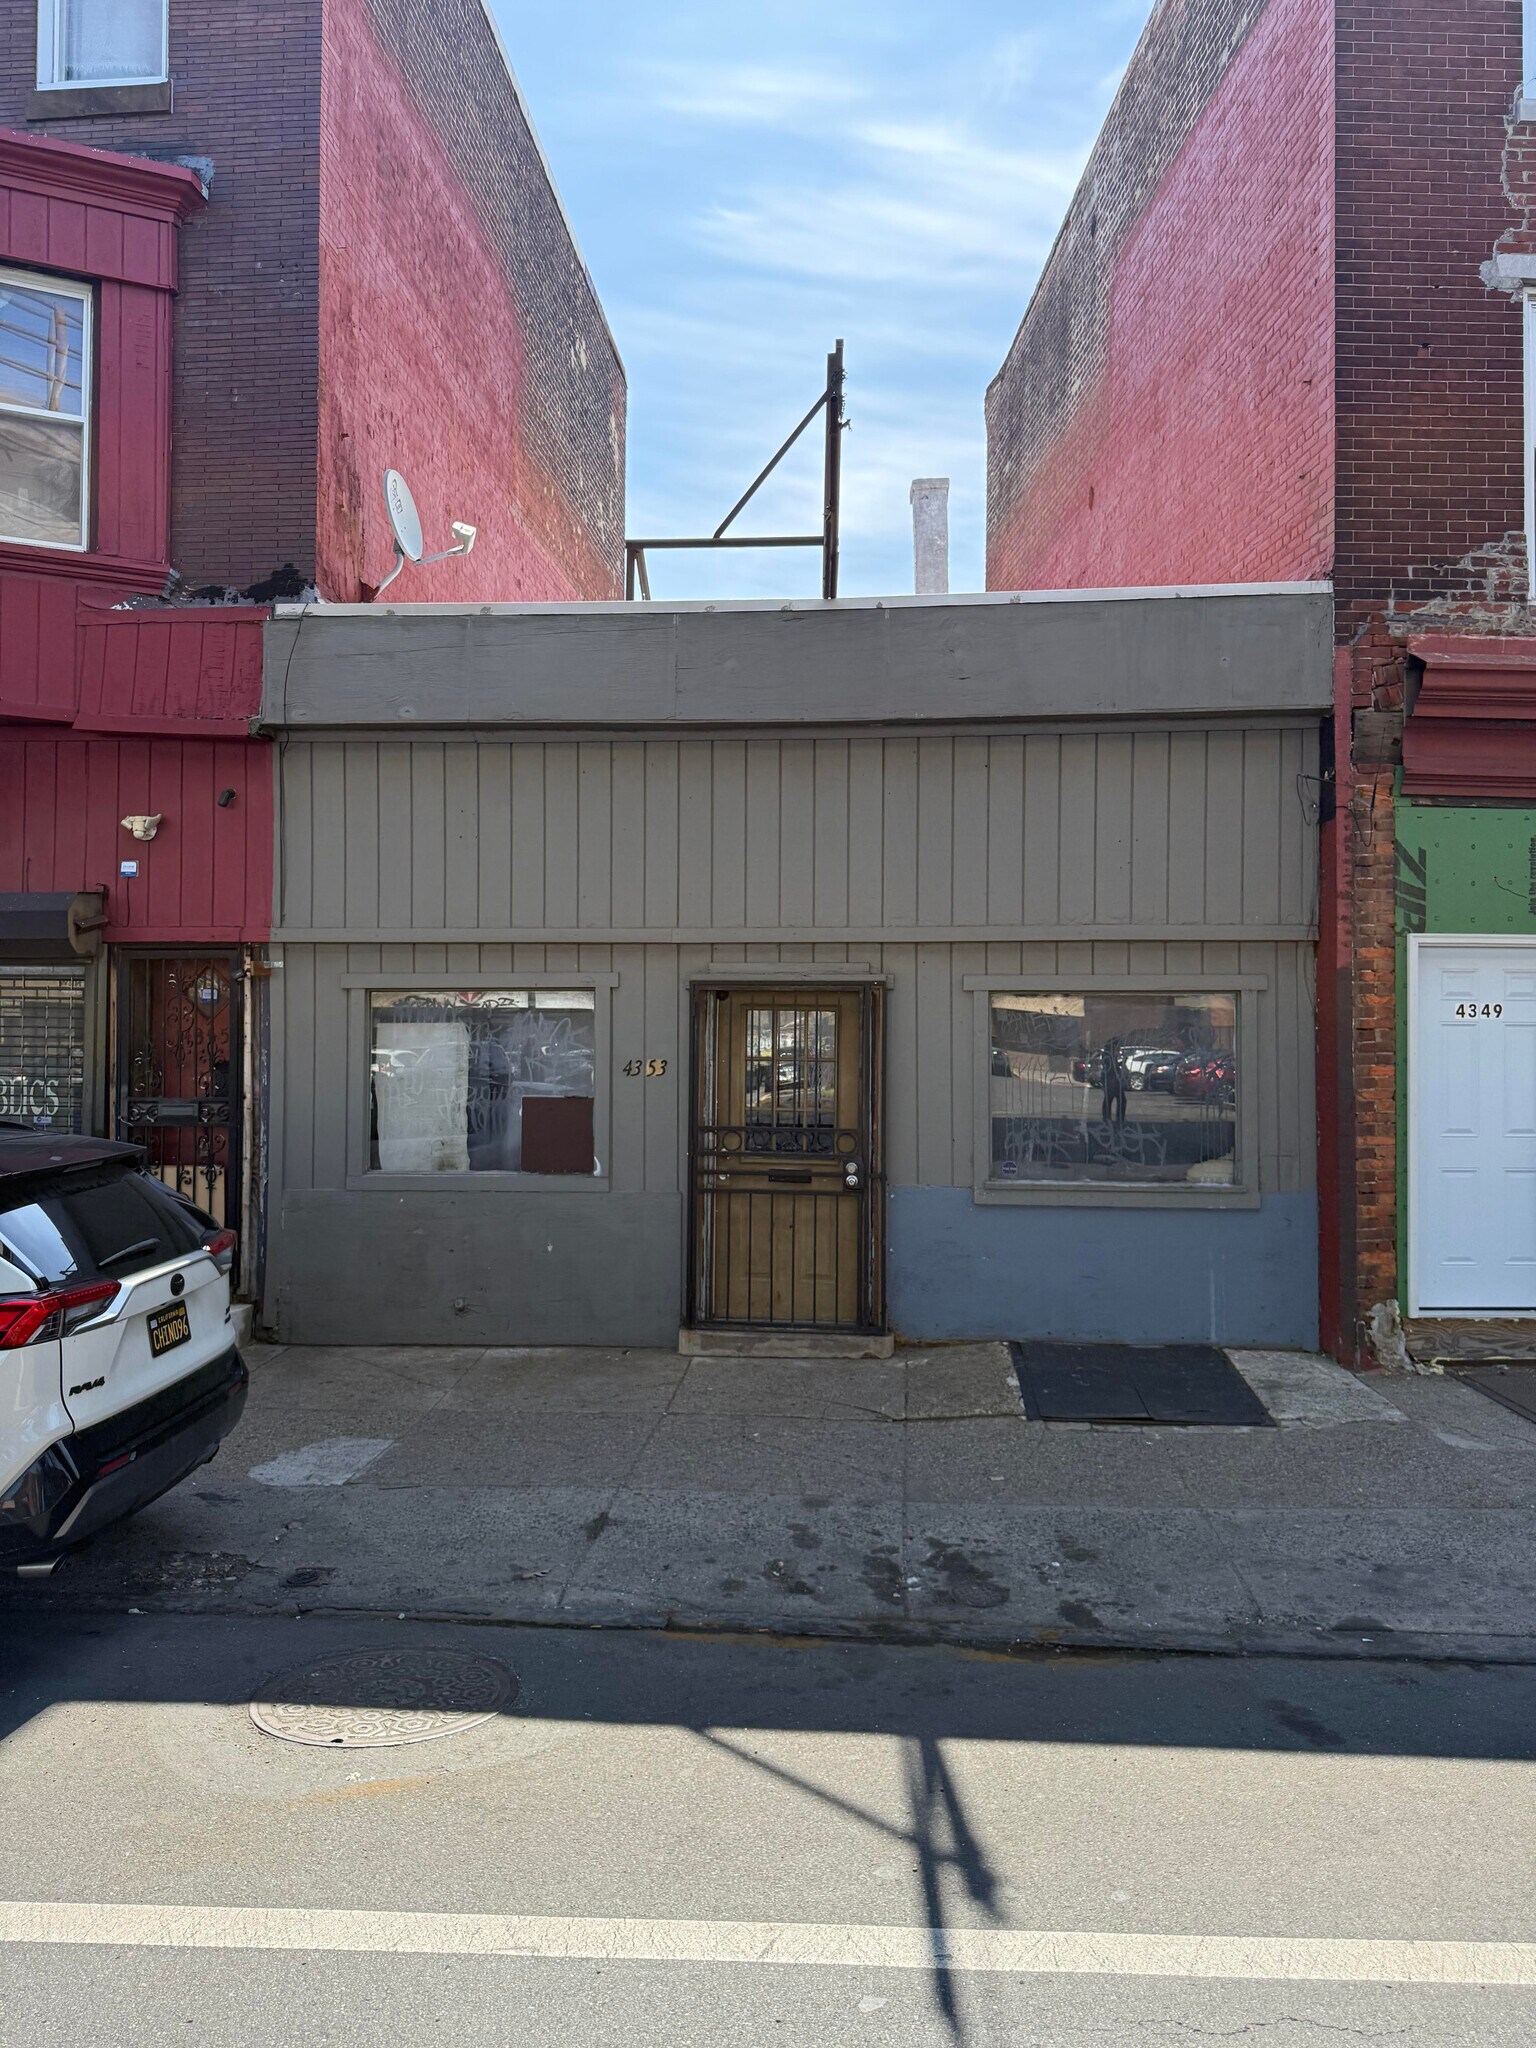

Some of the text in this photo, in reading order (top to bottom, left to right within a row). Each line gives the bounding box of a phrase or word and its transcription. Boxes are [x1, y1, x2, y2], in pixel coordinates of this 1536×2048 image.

[1394, 831, 1427, 934] ZIP
[1455, 1003, 1503, 1019] 4349
[622, 1059, 668, 1077] 4353
[69, 1375, 106, 1397] RAV4
